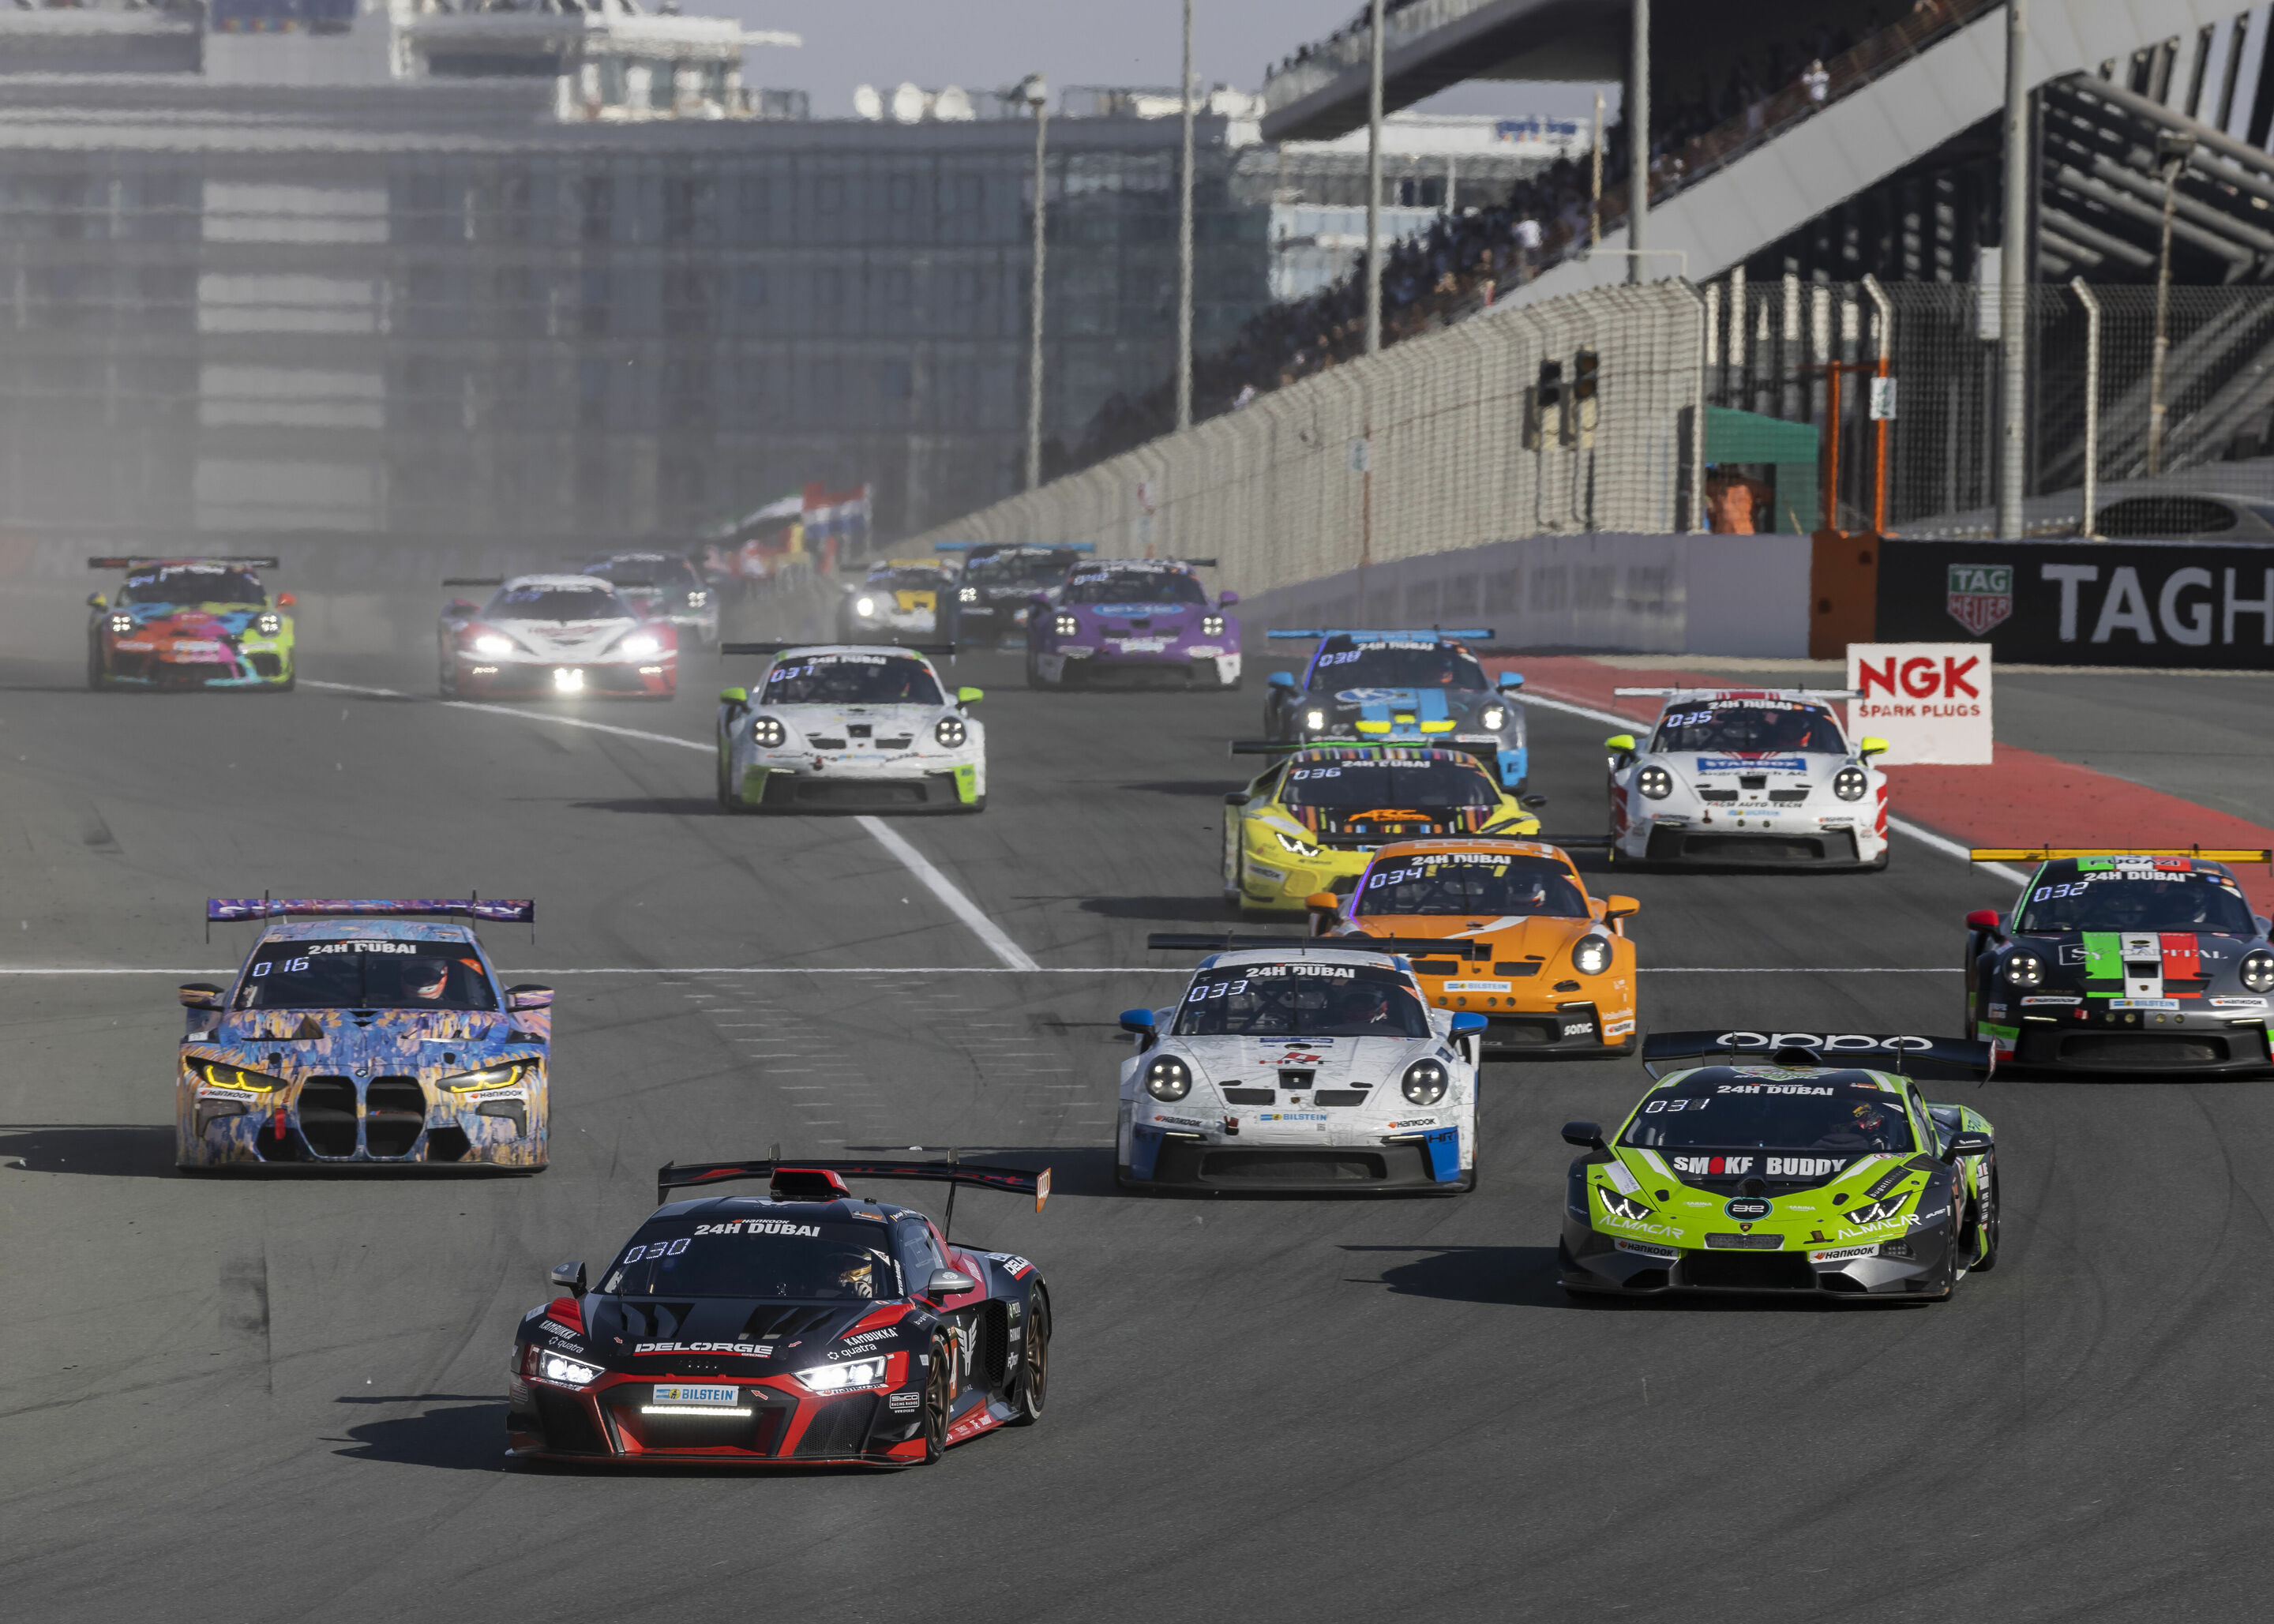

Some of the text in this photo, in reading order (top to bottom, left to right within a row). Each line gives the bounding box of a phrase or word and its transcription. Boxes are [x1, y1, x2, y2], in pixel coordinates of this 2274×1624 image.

[1954, 570, 2007, 591] TAG
[1949, 596, 2009, 630] HEUER
[1859, 655, 1979, 699] NGK
[1859, 704, 1981, 718] SPARK PLUGS
[1293, 767, 1342, 780] 036
[1411, 854, 1511, 866] 24H DUBAI
[1368, 867, 1423, 890] 034
[2084, 871, 2187, 883] 24H DUBAI
[2032, 881, 2089, 903] 032
[308, 943, 418, 955] 24H DUBAI
[1245, 966, 1356, 979] 24H DUBAI
[1188, 979, 1249, 1003] 033
[2134, 1000, 2176, 1008] BILSTEIN
[1717, 1085, 1834, 1096] 24H DUBAI
[1283, 1113, 1327, 1122] BILSTEIN
[1766, 1157, 1848, 1176] BUDDY
[1869, 1177, 1893, 1198] bugatti
[693, 1223, 821, 1238] 24H DUBAI
[1598, 1214, 1685, 1240] ALMACAR
[1837, 1213, 1923, 1240] ALMACAR
[623, 1237, 692, 1265] 030
[538, 1318, 577, 1341] KAMBUKKA
[843, 1327, 899, 1347] KAMBUKKA
[557, 1339, 585, 1355] quatra
[634, 1341, 774, 1356] DELORGE
[840, 1342, 878, 1358] quatra
[681, 1388, 734, 1401] BILSTEIN
